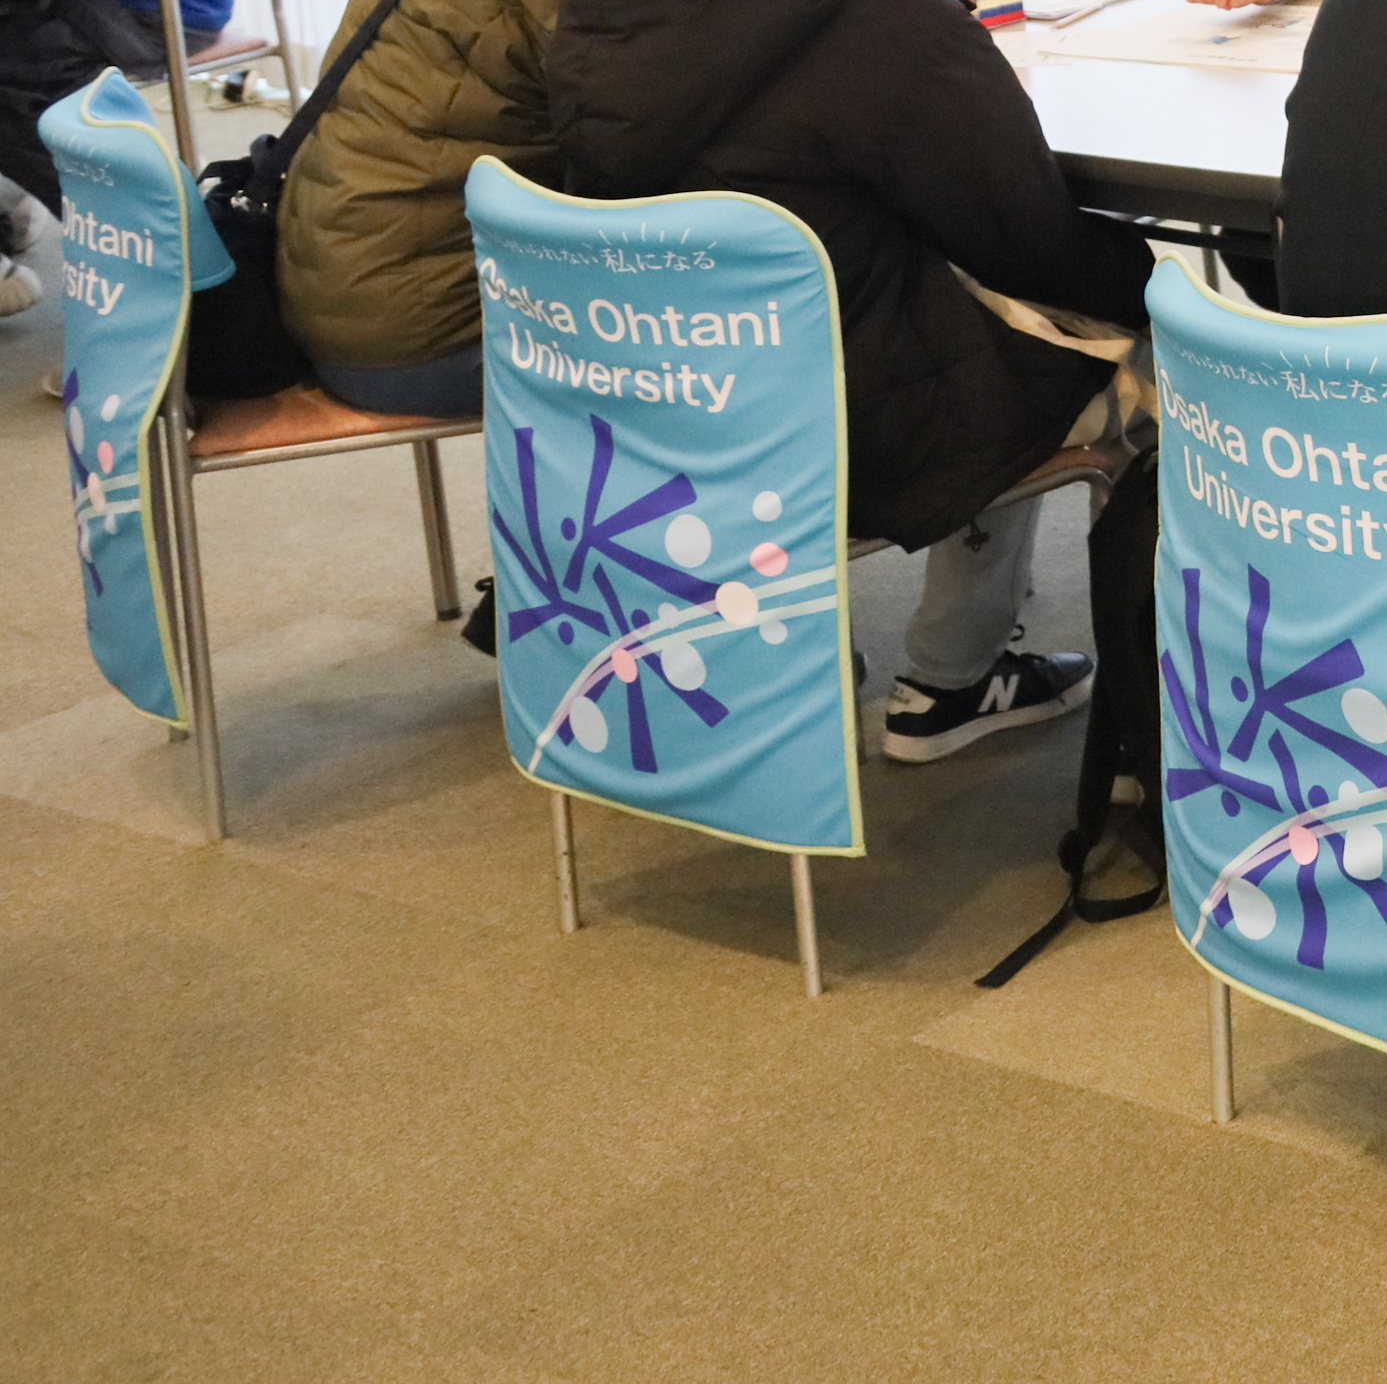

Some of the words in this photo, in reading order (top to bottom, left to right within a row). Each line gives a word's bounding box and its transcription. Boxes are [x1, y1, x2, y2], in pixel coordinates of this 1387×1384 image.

[588, 299, 781, 347] Ohtani
[509, 322, 736, 414] University
[1159, 368, 1249, 467] Osaka
[977, 674, 1020, 713] N
